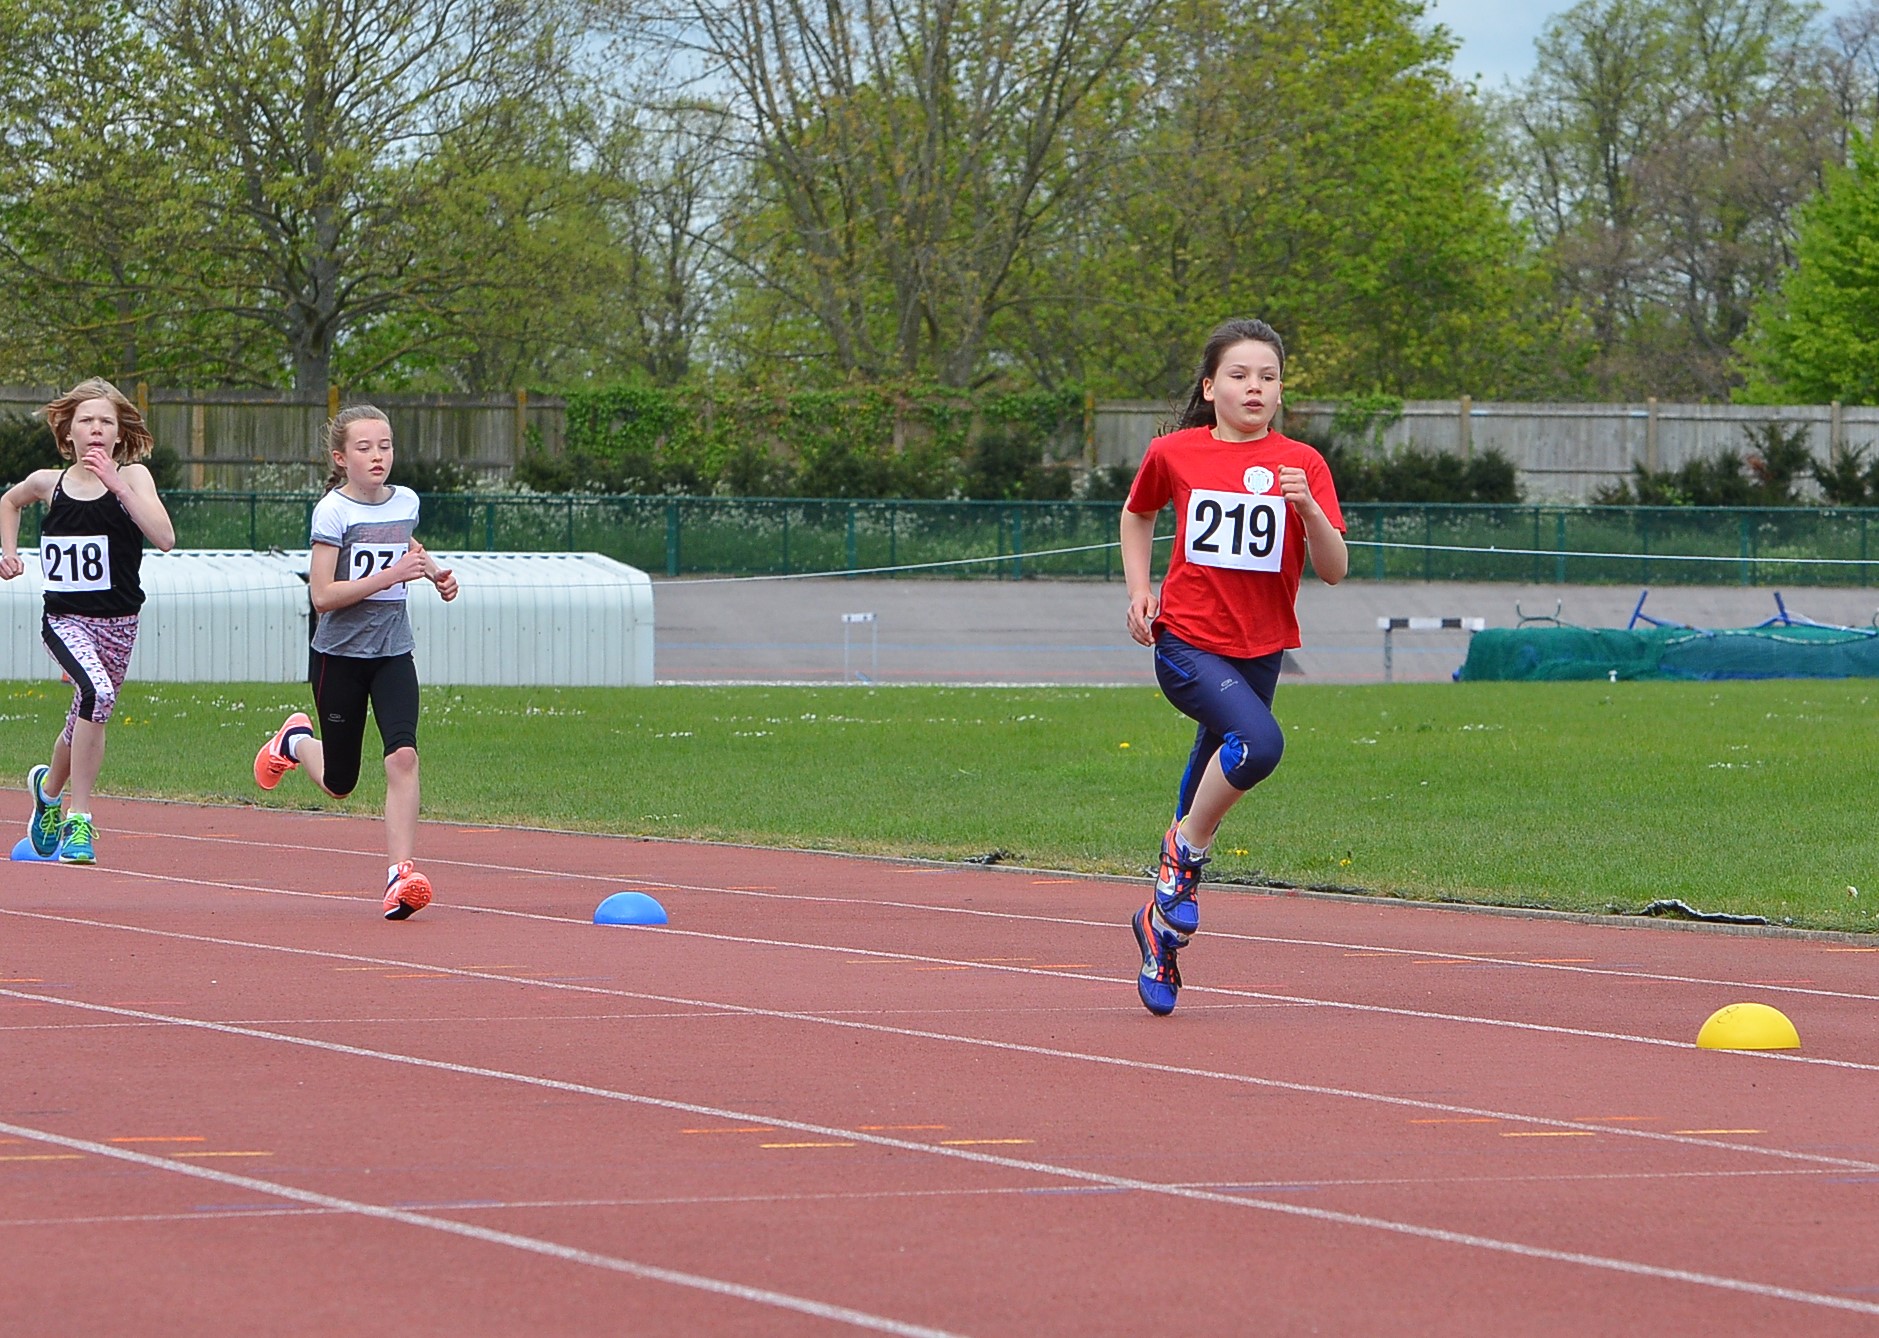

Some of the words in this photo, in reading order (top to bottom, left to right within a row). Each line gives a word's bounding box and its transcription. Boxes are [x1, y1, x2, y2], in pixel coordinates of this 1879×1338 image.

[1192, 499, 1276, 558] 219
[45, 542, 104, 582] 218
[354, 550, 407, 589] 23
